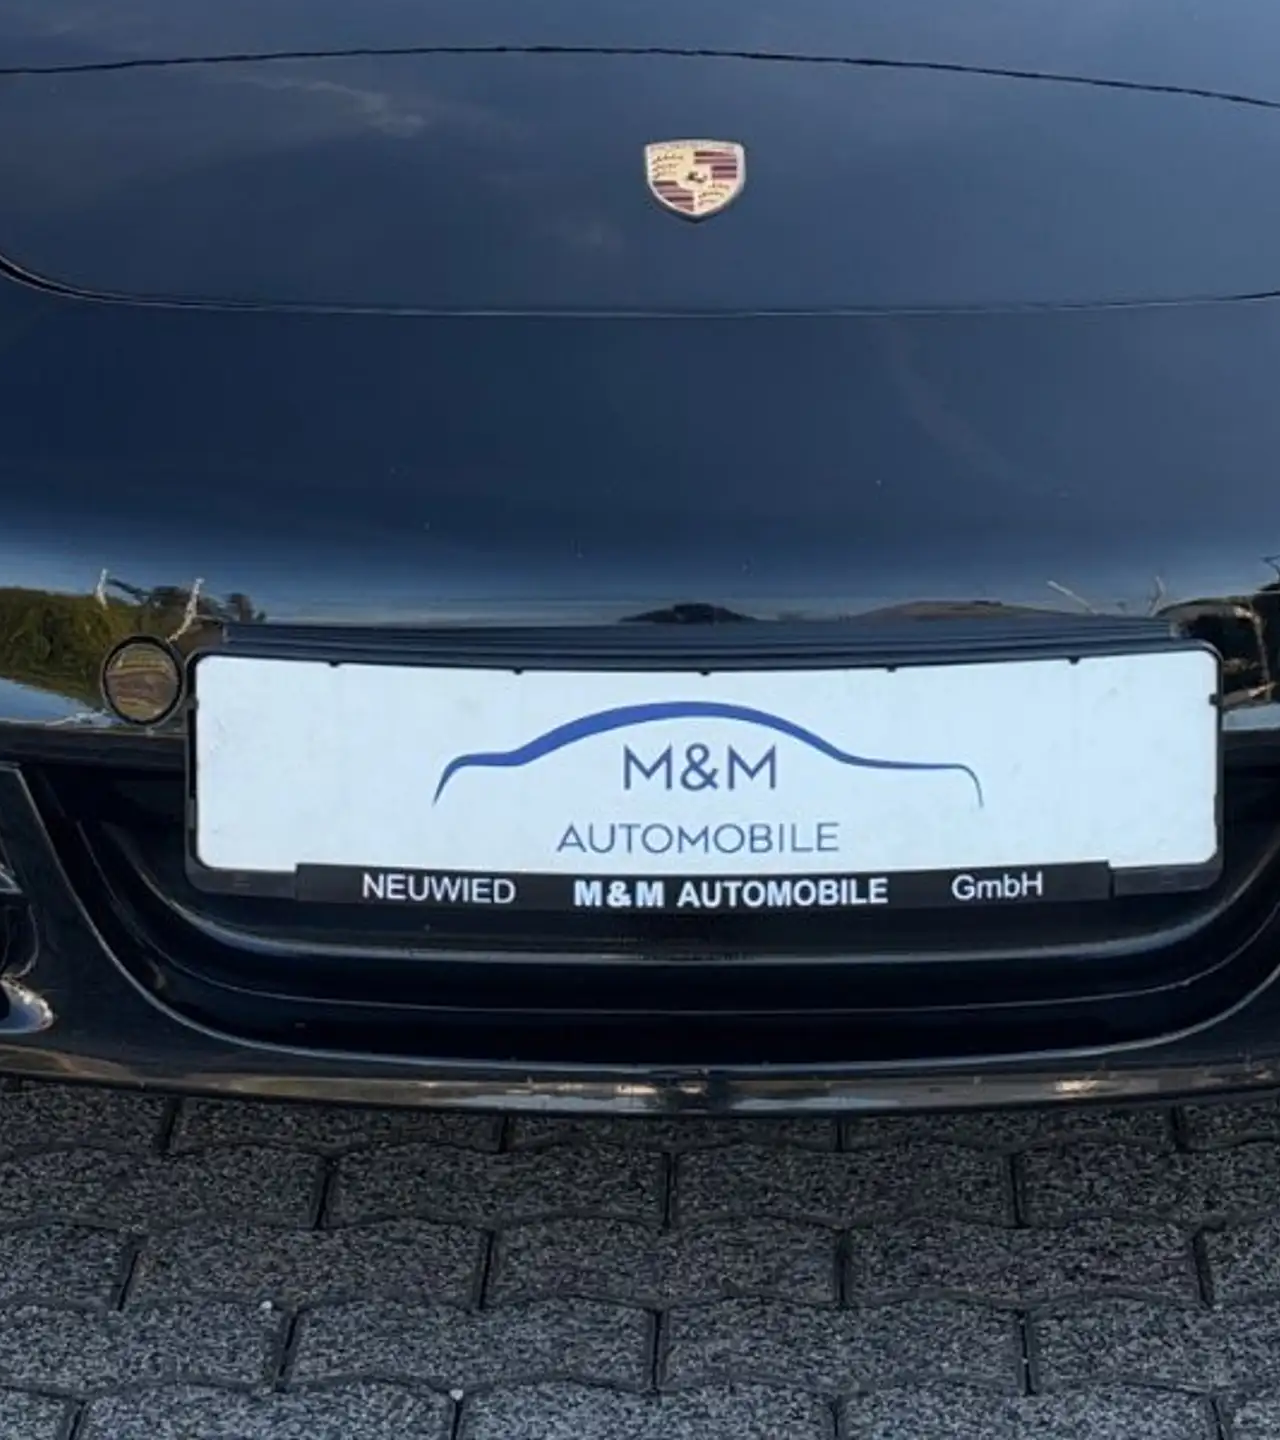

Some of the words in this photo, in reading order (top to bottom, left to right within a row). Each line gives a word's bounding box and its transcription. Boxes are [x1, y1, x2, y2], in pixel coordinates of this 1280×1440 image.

[623, 742, 777, 792] M&M
[556, 822, 840, 854] AUTOMOBILE
[362, 872, 517, 904] NEUWIED
[573, 879, 665, 908] M&M
[676, 877, 889, 908] AUTOMOBILE
[951, 872, 1044, 902] GmbH
